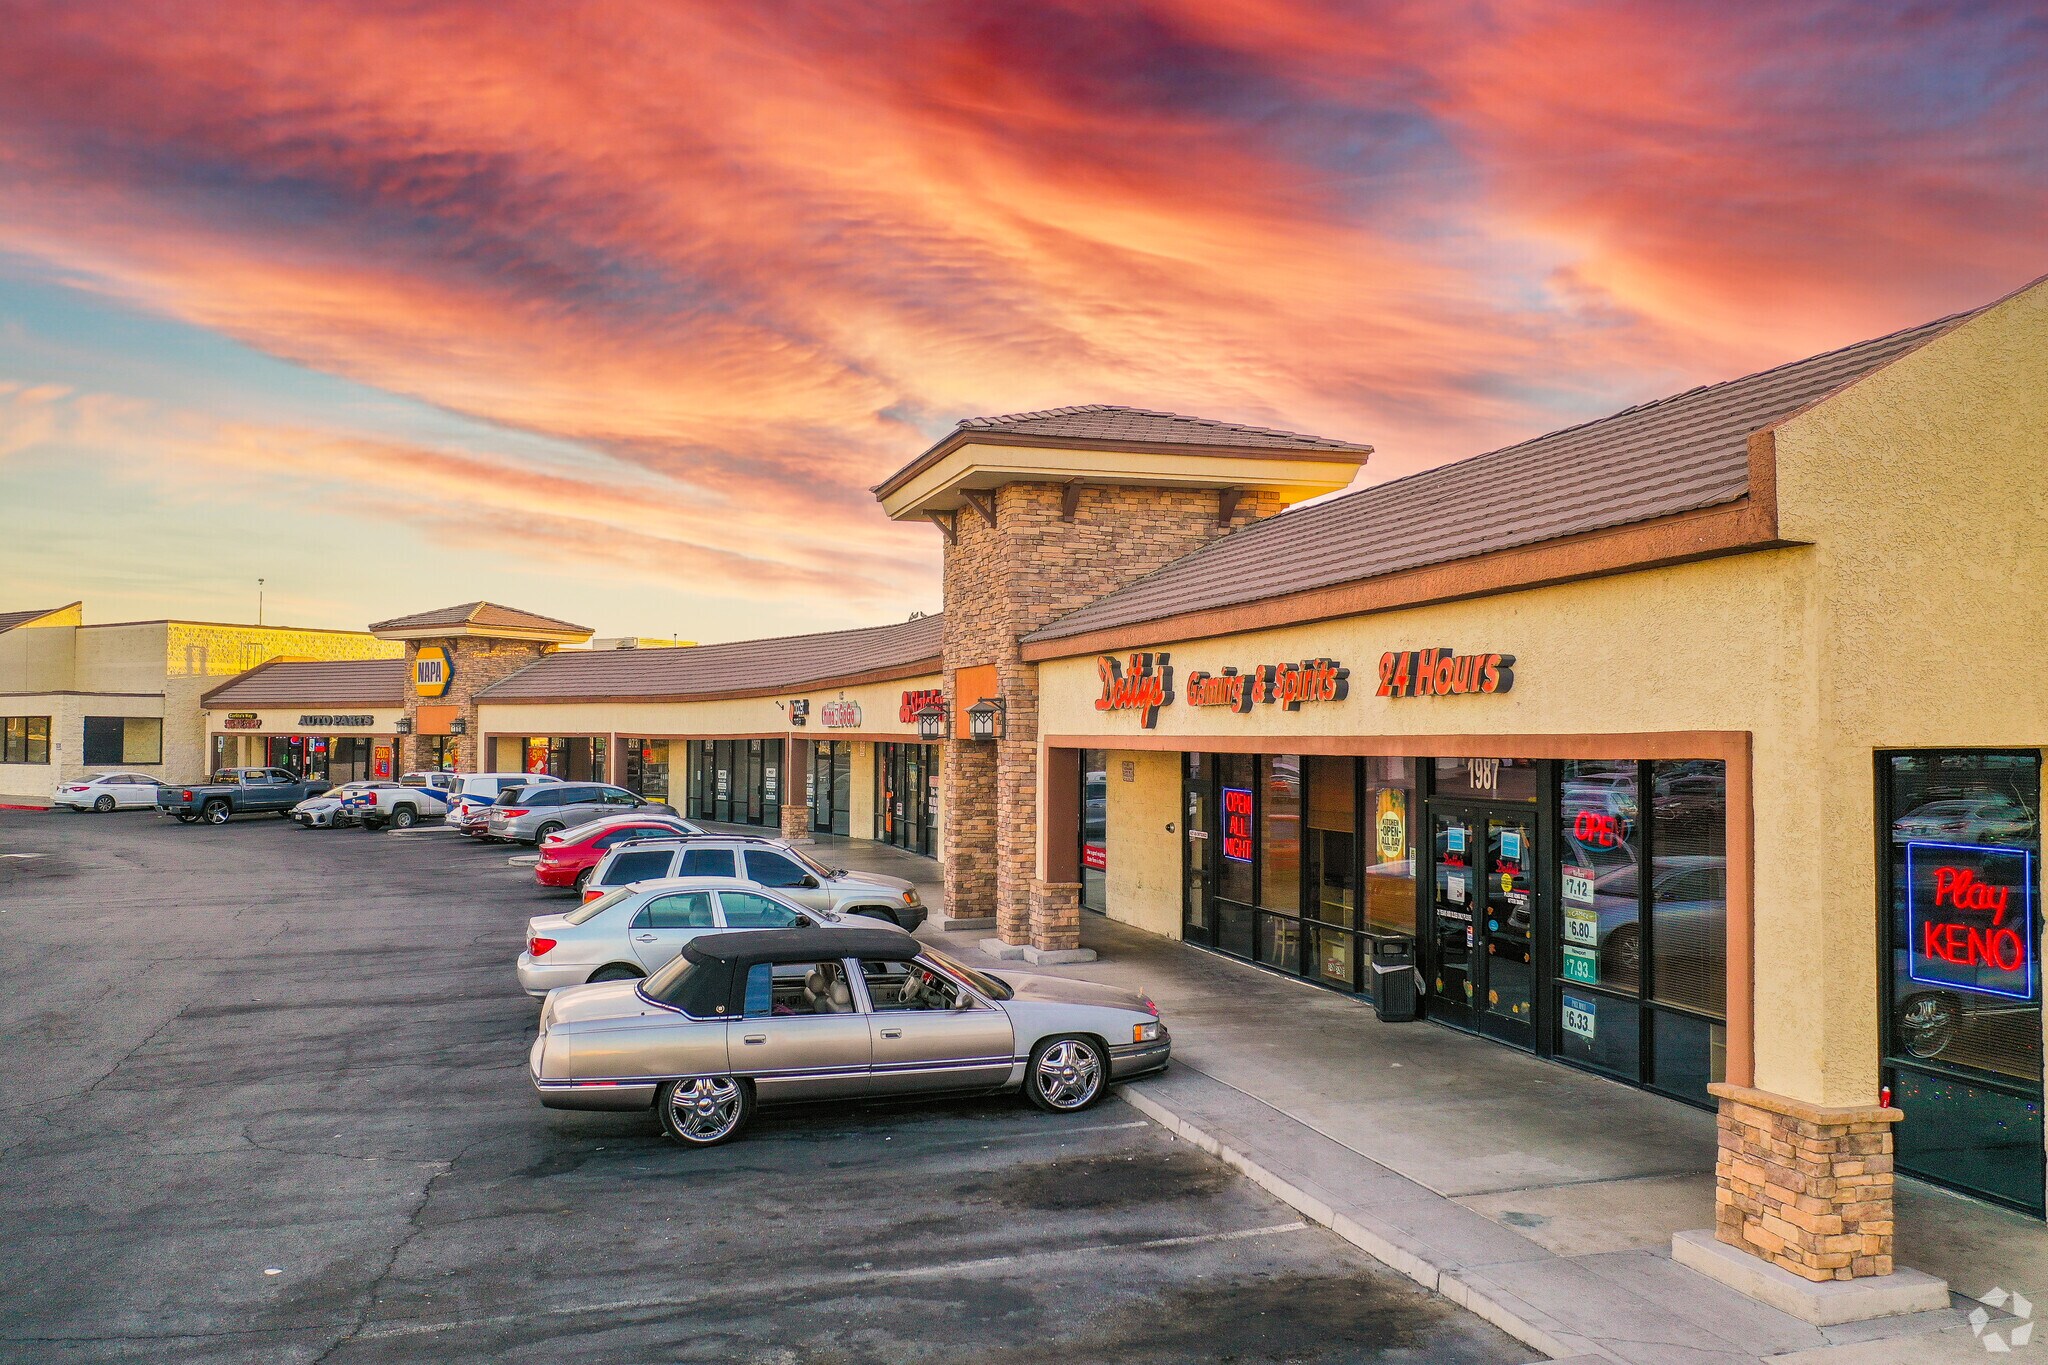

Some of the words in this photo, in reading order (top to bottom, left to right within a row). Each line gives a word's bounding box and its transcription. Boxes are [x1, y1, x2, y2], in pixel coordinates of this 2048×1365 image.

[417, 661, 442, 683] NAPA
[1187, 666, 1250, 713] Gaming
[1252, 665, 1270, 703] &
[1272, 658, 1344, 711] Spirits
[1375, 651, 1411, 698] 24
[1414, 648, 1507, 697] Hours
[298, 715, 332, 726] AUTO
[333, 715, 374, 726] PARTS
[1467, 758, 1499, 790] 1987
[1226, 791, 1251, 815] OPEN
[1229, 815, 1248, 838] ALL
[1382, 825, 1399, 837] OPEN
[1574, 810, 1626, 849] OPEN
[1225, 837, 1252, 859] NIGHT
[1381, 837, 1391, 846] ALL
[1566, 878, 1588, 897] $7.12
[1933, 866, 2009, 926] Play
[1569, 921, 1590, 938] $6.80
[1925, 920, 2025, 972] KENO
[1566, 958, 1589, 979] $7.93
[1566, 1010, 1589, 1032] $6.33
